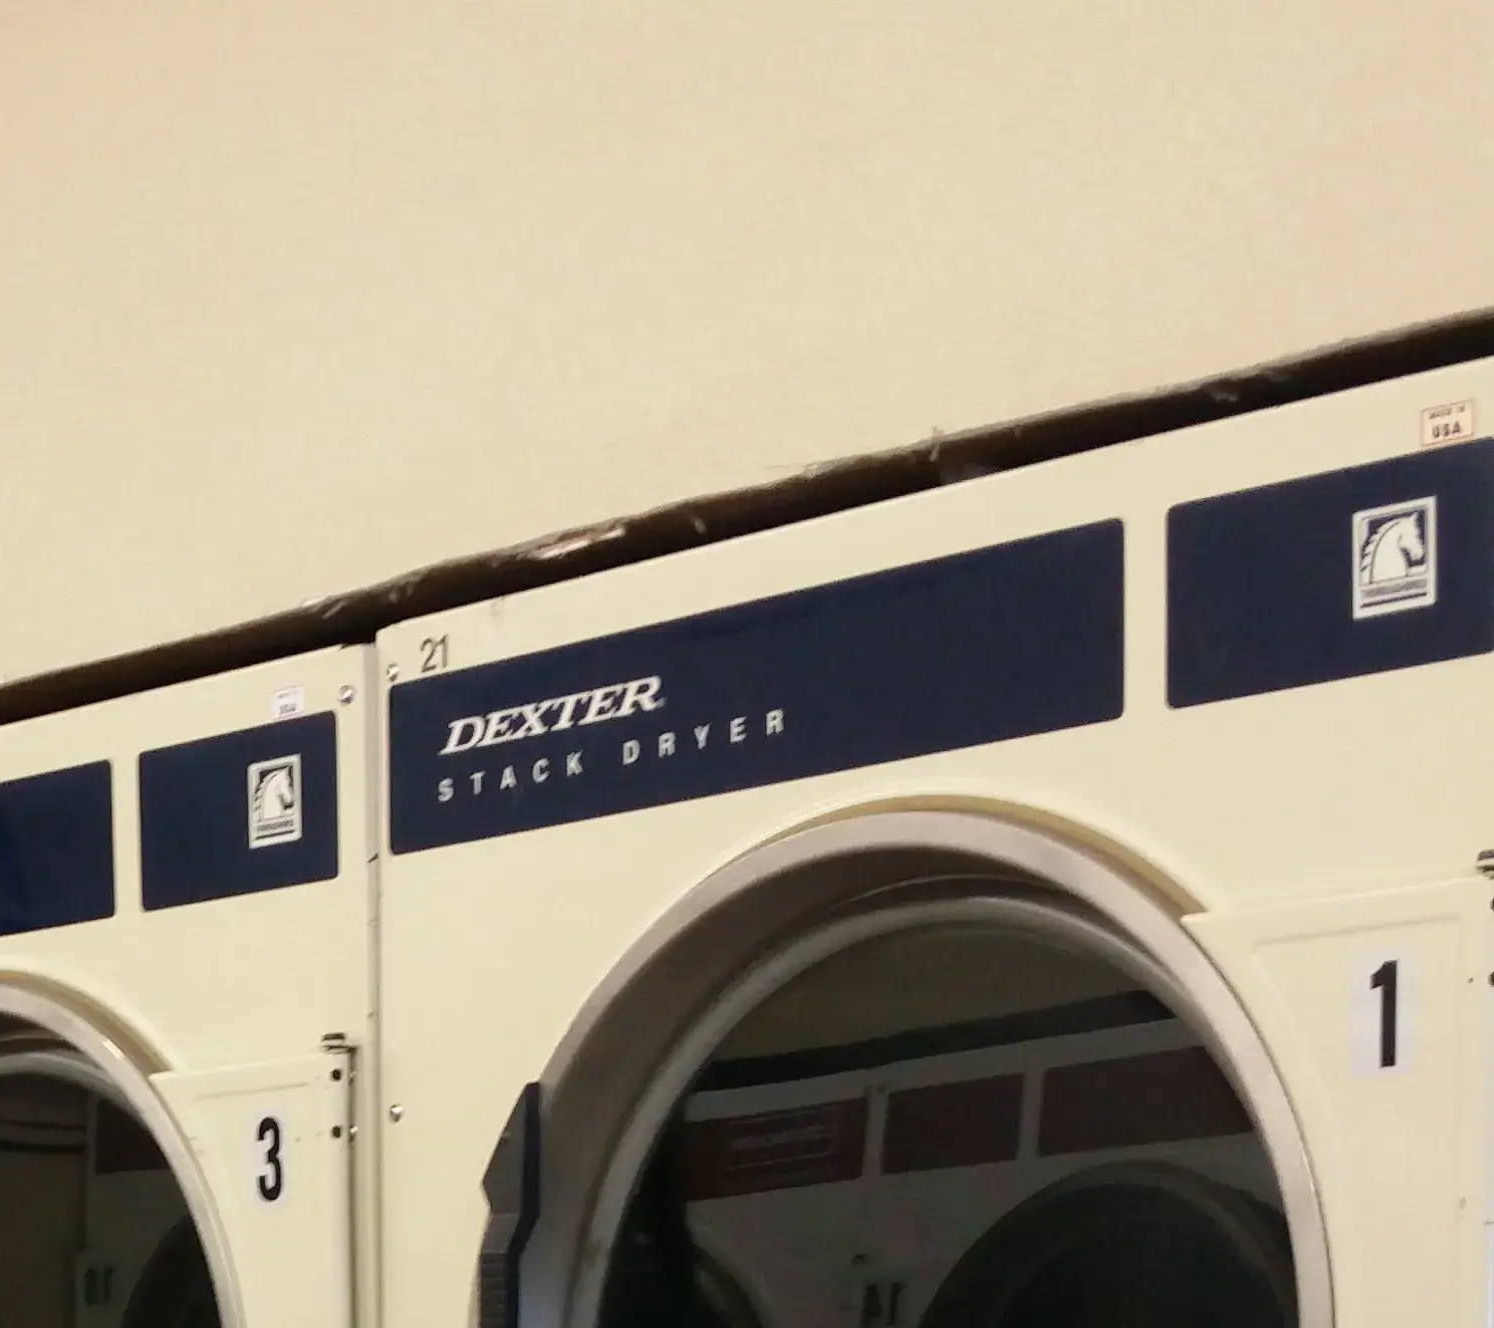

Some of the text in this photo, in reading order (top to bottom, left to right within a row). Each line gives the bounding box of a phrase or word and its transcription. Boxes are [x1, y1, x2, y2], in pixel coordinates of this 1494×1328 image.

[419, 634, 449, 673] 21
[437, 708, 786, 803] STACK DRYER
[438, 675, 665, 756] DEXTER
[1369, 959, 1399, 1068] 1
[256, 1116, 282, 1202] 3
